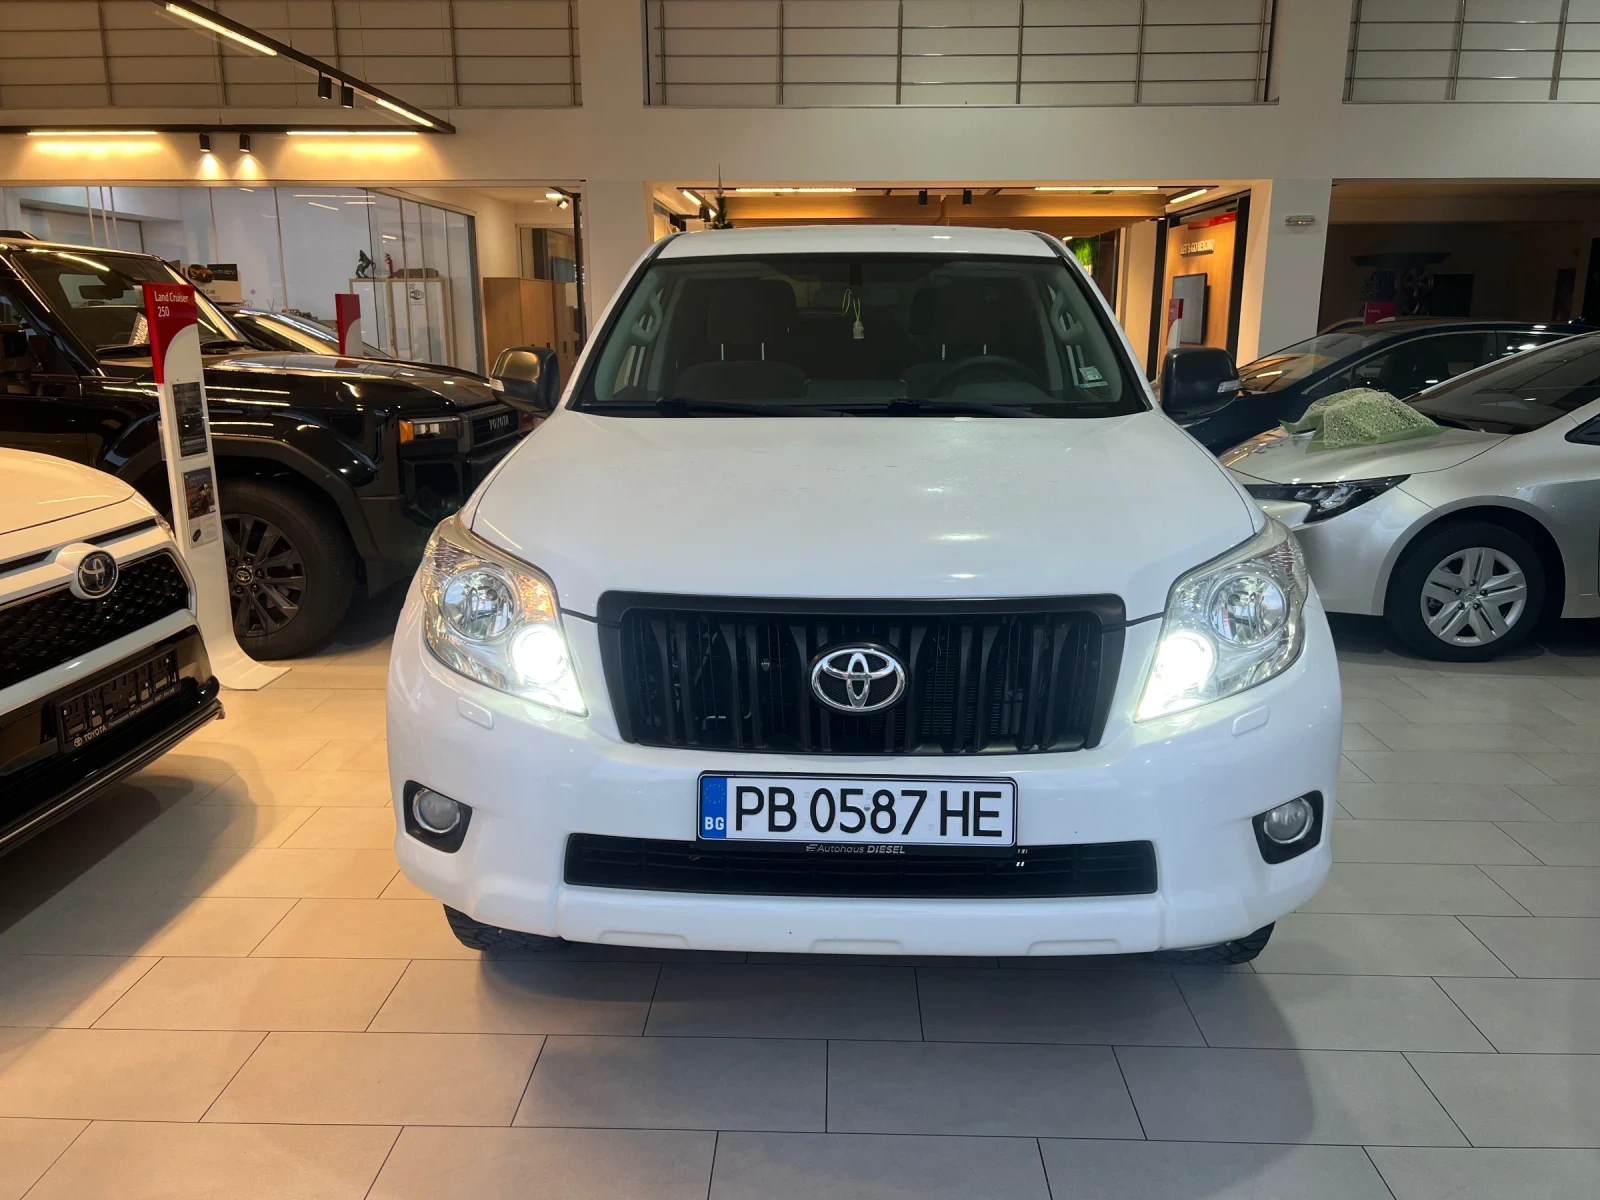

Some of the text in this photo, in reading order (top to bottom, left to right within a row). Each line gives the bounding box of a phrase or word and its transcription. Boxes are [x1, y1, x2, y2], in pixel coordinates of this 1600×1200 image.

[154, 290, 189, 303] Land Cruiser
[157, 305, 170, 317] 250
[489, 414, 510, 431] TOYOTA
[83, 724, 107, 742] TOYOTA
[735, 785, 1003, 838] PB 0587 HE
[704, 816, 725, 831] BG
[817, 844, 906, 854] Autohaus DIESEL
